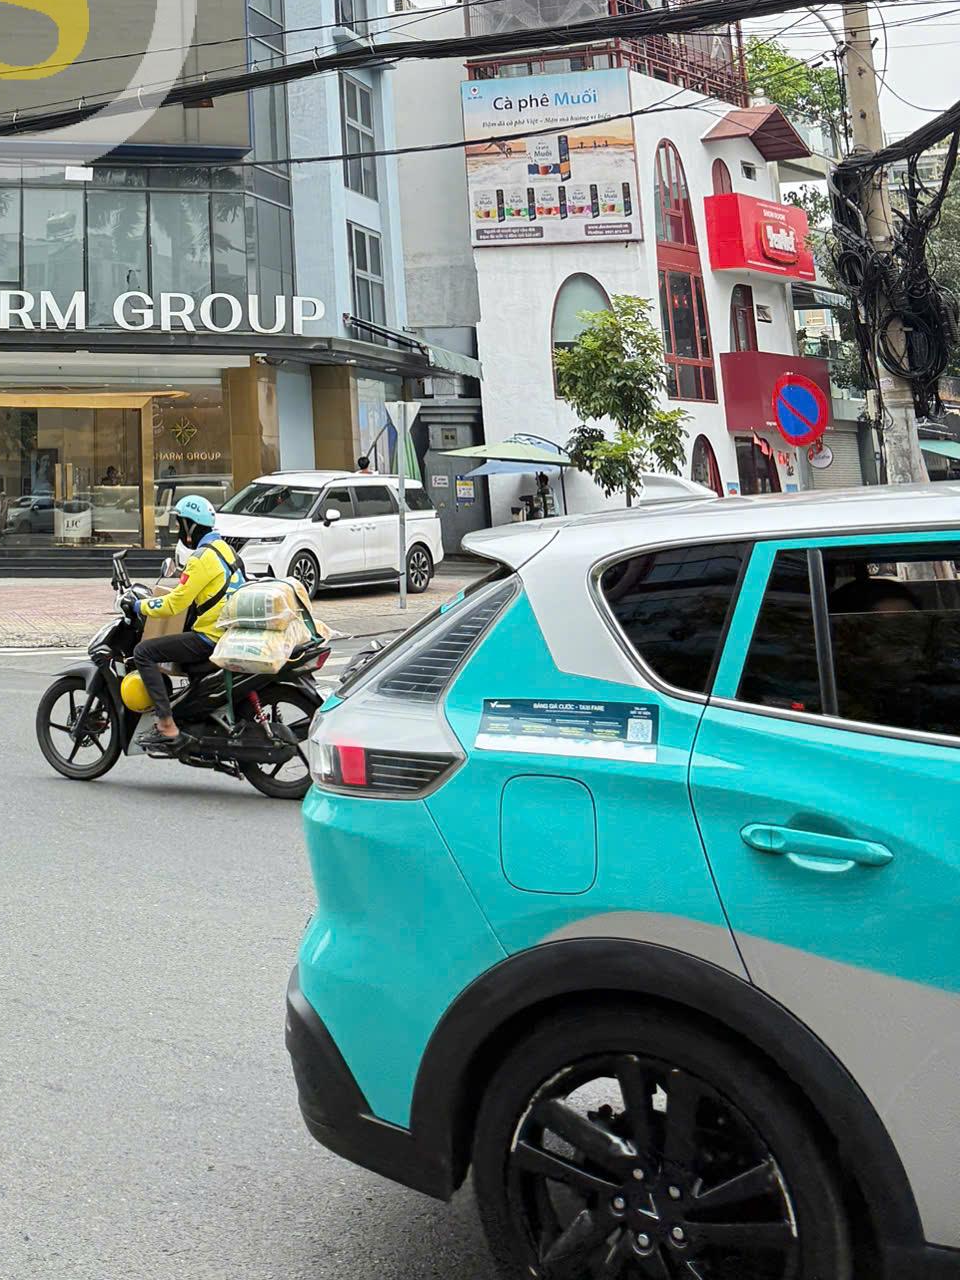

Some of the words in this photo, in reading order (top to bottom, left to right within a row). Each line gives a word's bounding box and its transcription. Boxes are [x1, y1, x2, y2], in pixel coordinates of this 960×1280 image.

[492, 95, 513, 111] Cà
[518, 94, 550, 113] phê
[553, 87, 599, 107] Muối
[112, 291, 327, 335] GROUP
[153, 451, 183, 461] HARM
[186, 451, 221, 461] GROUP
